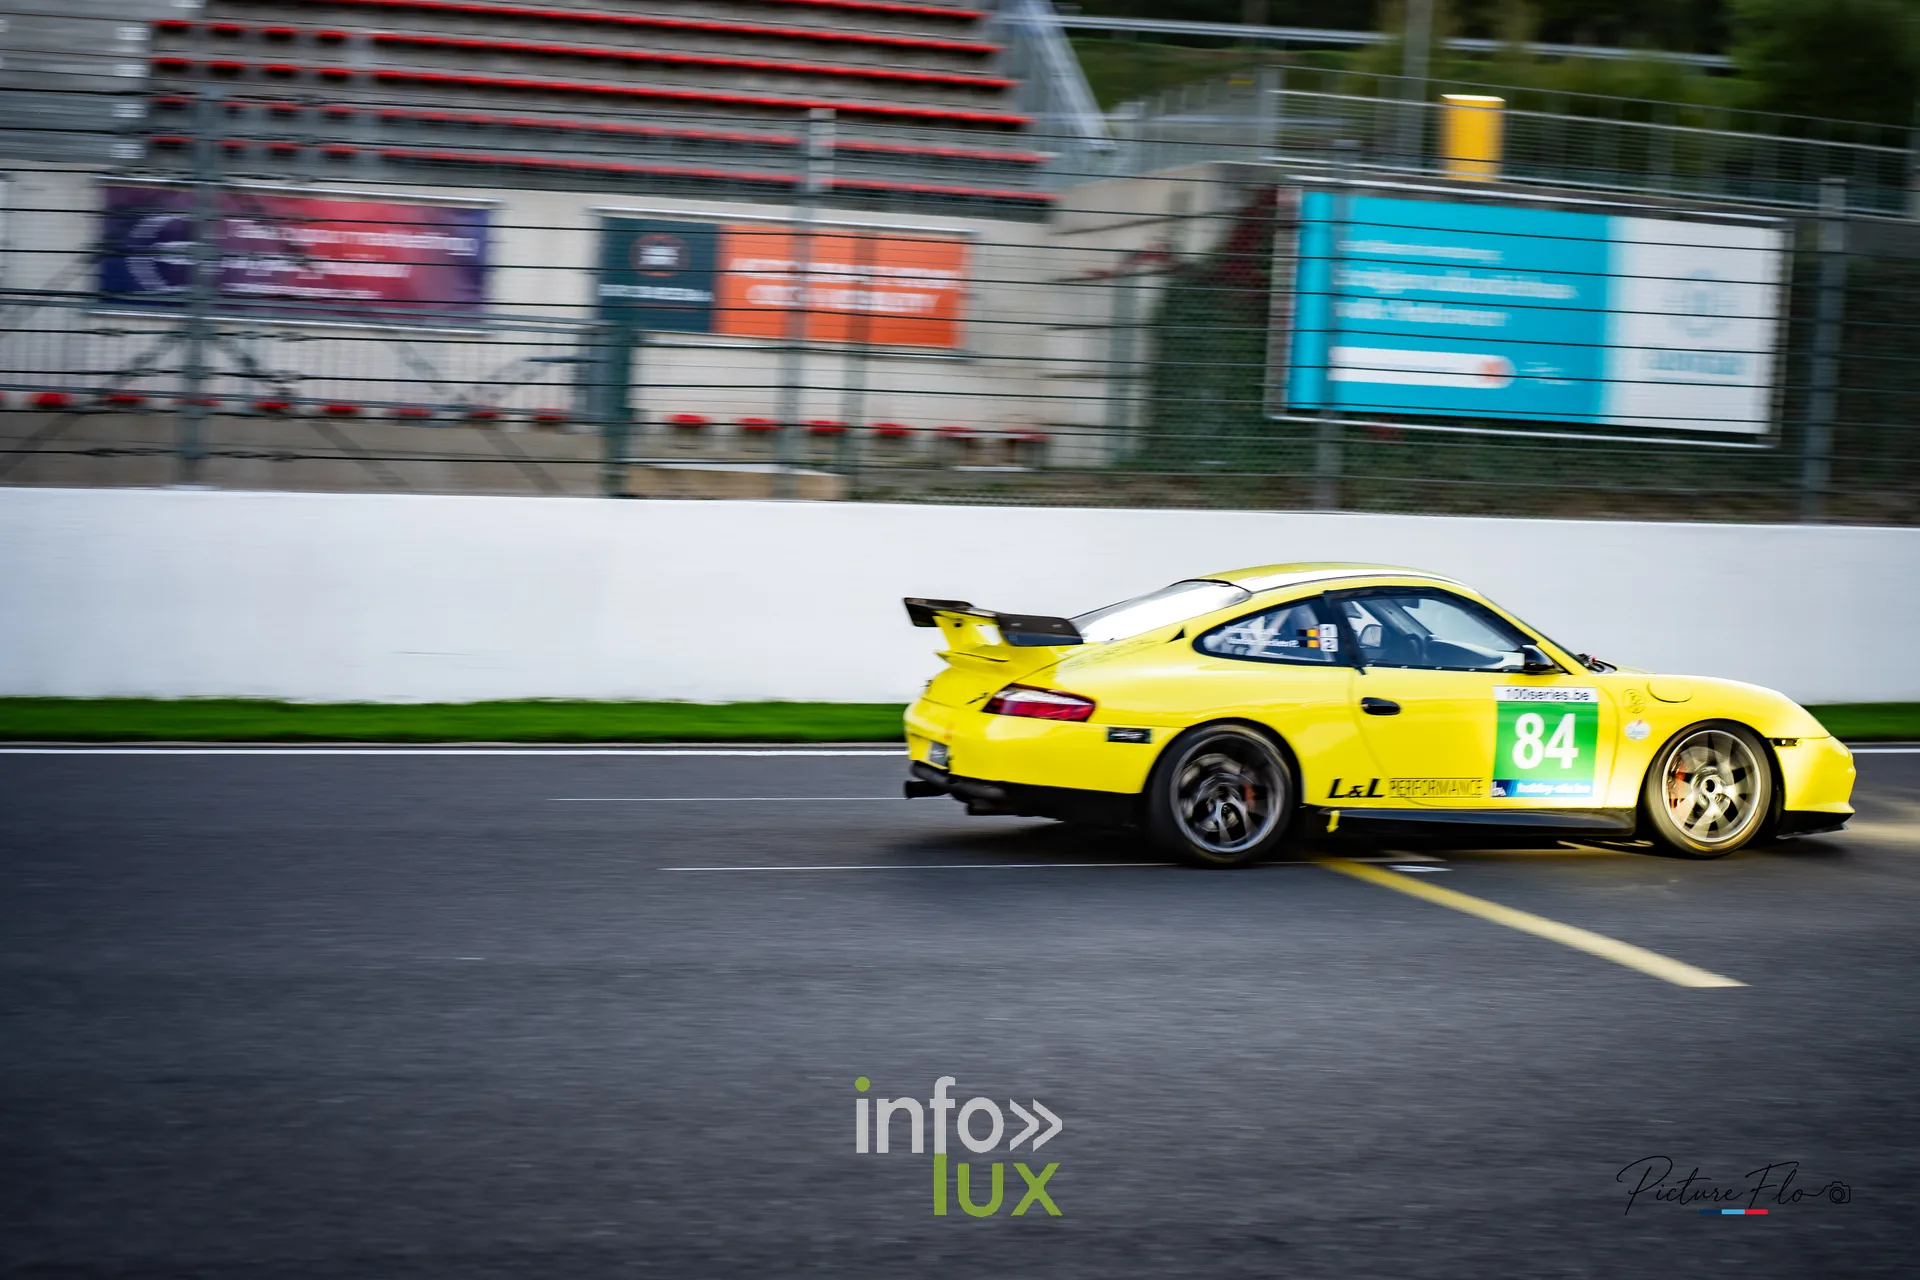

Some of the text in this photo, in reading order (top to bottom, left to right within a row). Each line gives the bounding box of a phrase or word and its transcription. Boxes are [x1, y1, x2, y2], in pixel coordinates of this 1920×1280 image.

[1504, 687, 1592, 701] 100series.be
[1511, 712, 1580, 770] 84
[1326, 777, 1386, 798] L&L
[1389, 779, 1483, 797] PERFORMANCE
